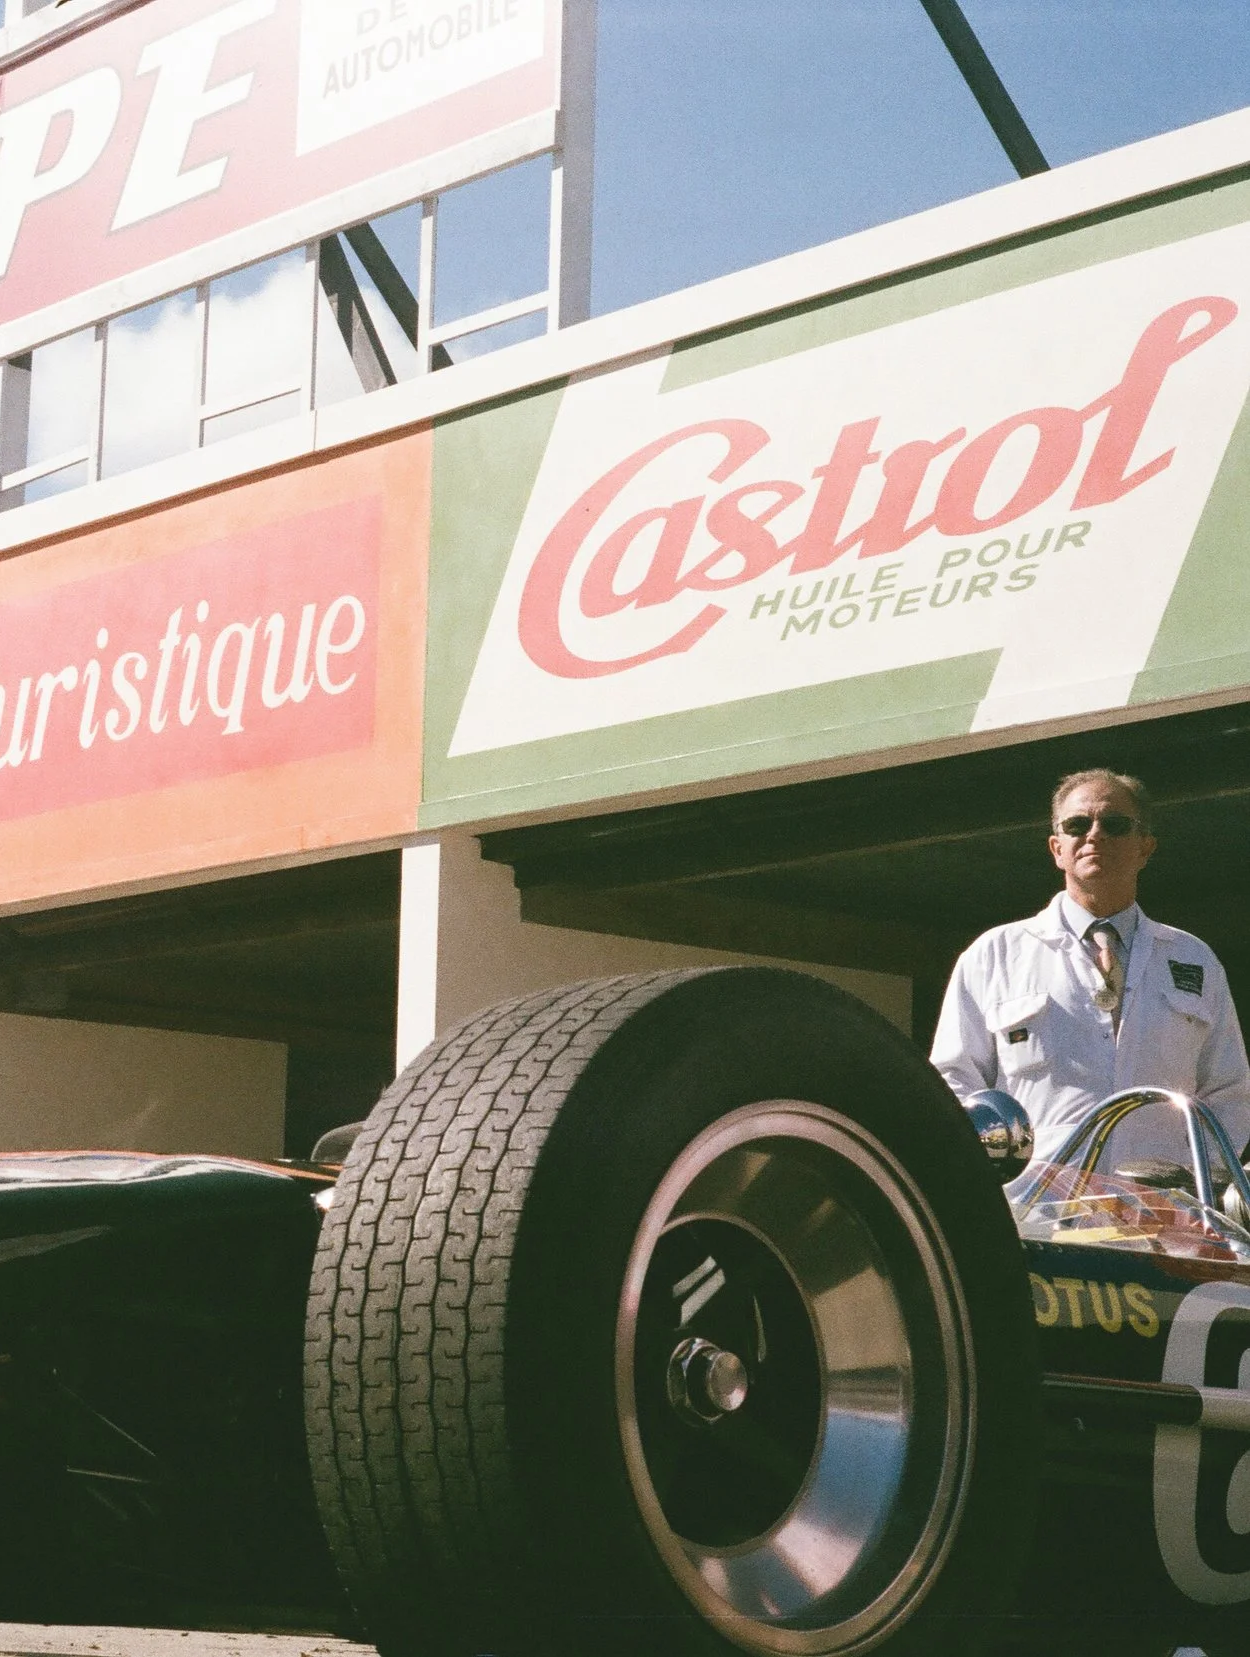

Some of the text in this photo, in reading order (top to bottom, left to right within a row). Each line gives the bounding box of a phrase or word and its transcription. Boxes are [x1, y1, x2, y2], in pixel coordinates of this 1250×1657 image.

[322, 0, 519, 99] AUTOMOBILE
[356, 0, 408, 36] DE
[517, 296, 1240, 679] Castrol
[749, 520, 1092, 620] HUILE POUR
[779, 562, 1039, 643] MOTEURS
[1028, 1272, 1160, 1338] OTUS
